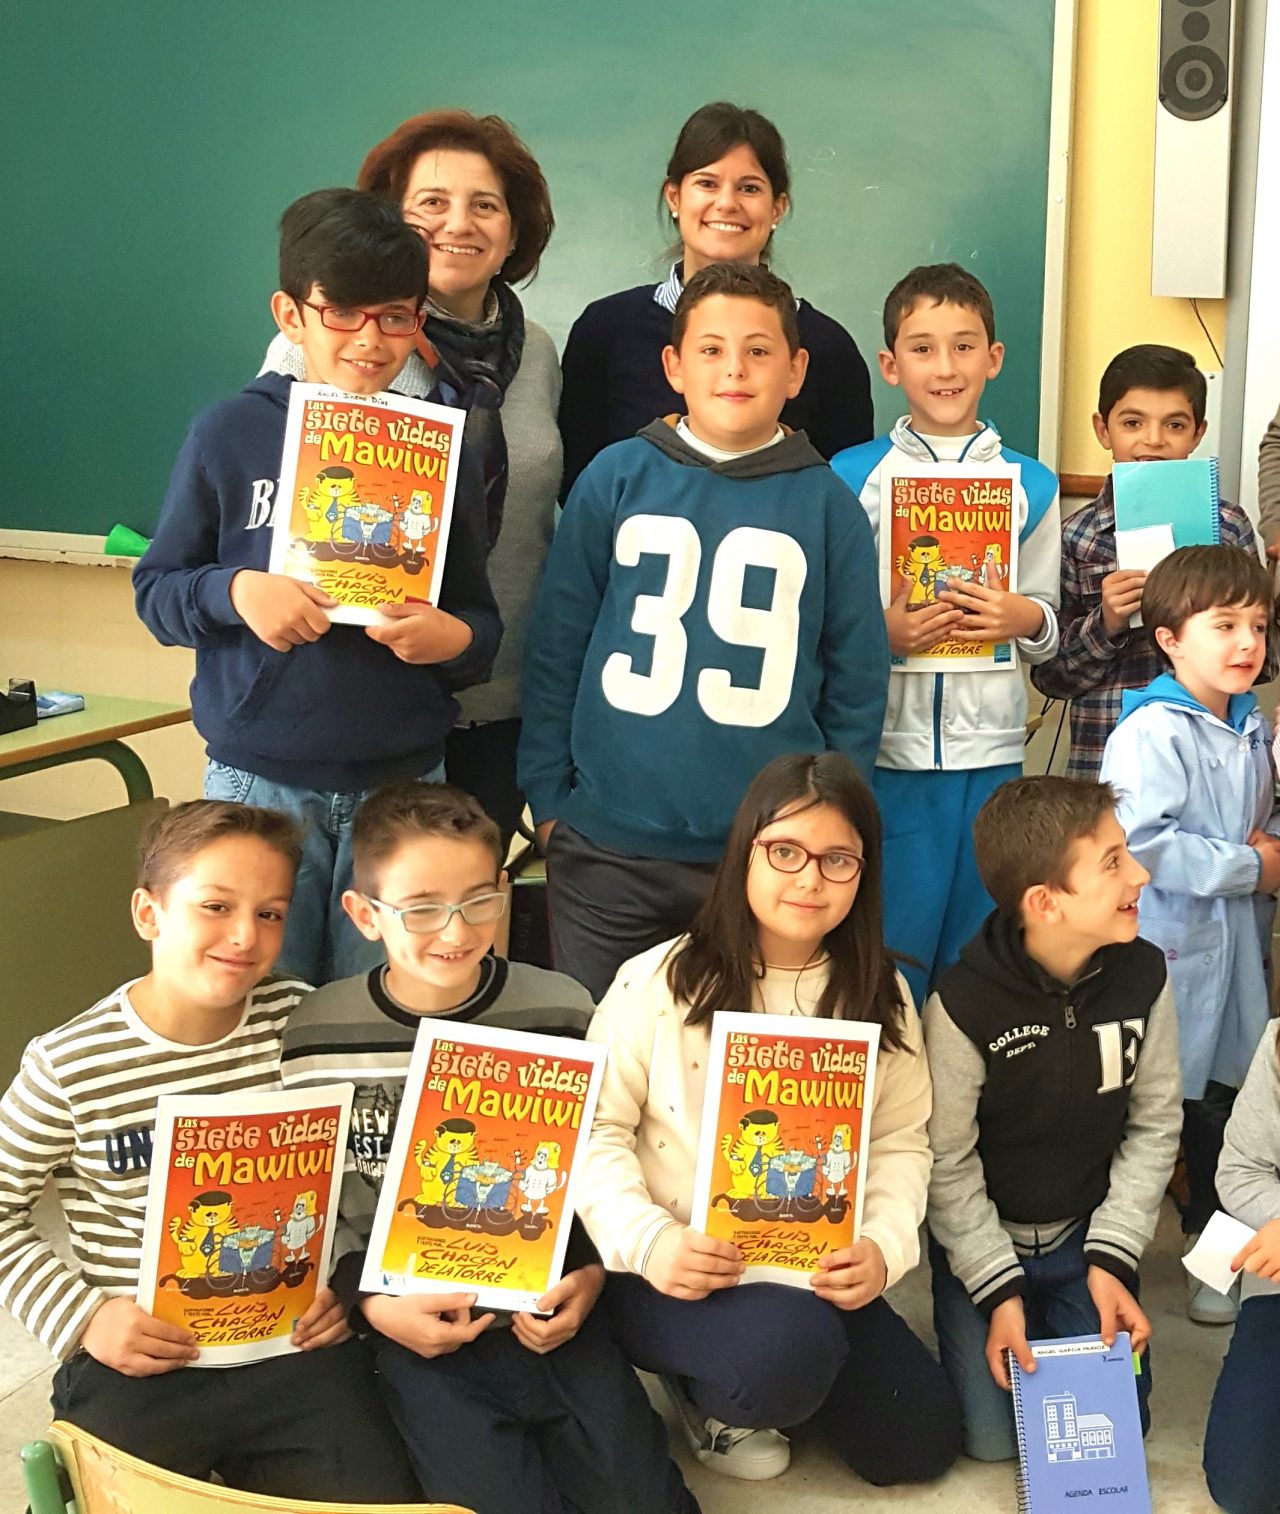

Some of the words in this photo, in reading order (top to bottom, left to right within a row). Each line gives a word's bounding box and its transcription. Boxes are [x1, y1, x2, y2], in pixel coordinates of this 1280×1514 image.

[307, 401, 324, 411] Las
[305, 404, 381, 436] siete
[387, 417, 450, 453] vidas
[304, 431, 321, 445] de
[320, 431, 448, 482] Mawiwi
[894, 478, 909, 486] Las
[894, 480, 956, 505] siete
[961, 481, 1012, 506] vidas
[244, 479, 280, 529] B
[895, 505, 909, 517] de
[909, 505, 1011, 532] Mawiwi
[602, 514, 808, 728] 39
[435, 1039, 454, 1052] Las
[730, 1033, 748, 1044] Las
[988, 1024, 1050, 1052] COLLEGE
[728, 1037, 805, 1071] siete
[810, 1042, 866, 1075] vidas
[1091, 1017, 1145, 1094] E
[430, 1045, 511, 1083] siete
[517, 1058, 589, 1096] vidas
[427, 1075, 447, 1092] de
[442, 1077, 585, 1130] Mawiwi
[727, 1068, 745, 1084] de
[744, 1069, 865, 1109] Mawiwi
[175, 1120, 261, 1151] siete
[268, 1113, 338, 1148] vidas
[177, 1117, 198, 1129] Las
[351, 1108, 389, 1135] NEW
[354, 1134, 384, 1159] EST
[174, 1152, 194, 1169] de
[194, 1143, 336, 1186] Mawiwi
[446, 1237, 498, 1255] LUIS
[1065, 1490, 1093, 1498] AGENDA
[1099, 1485, 1128, 1495] ESCOLAR
